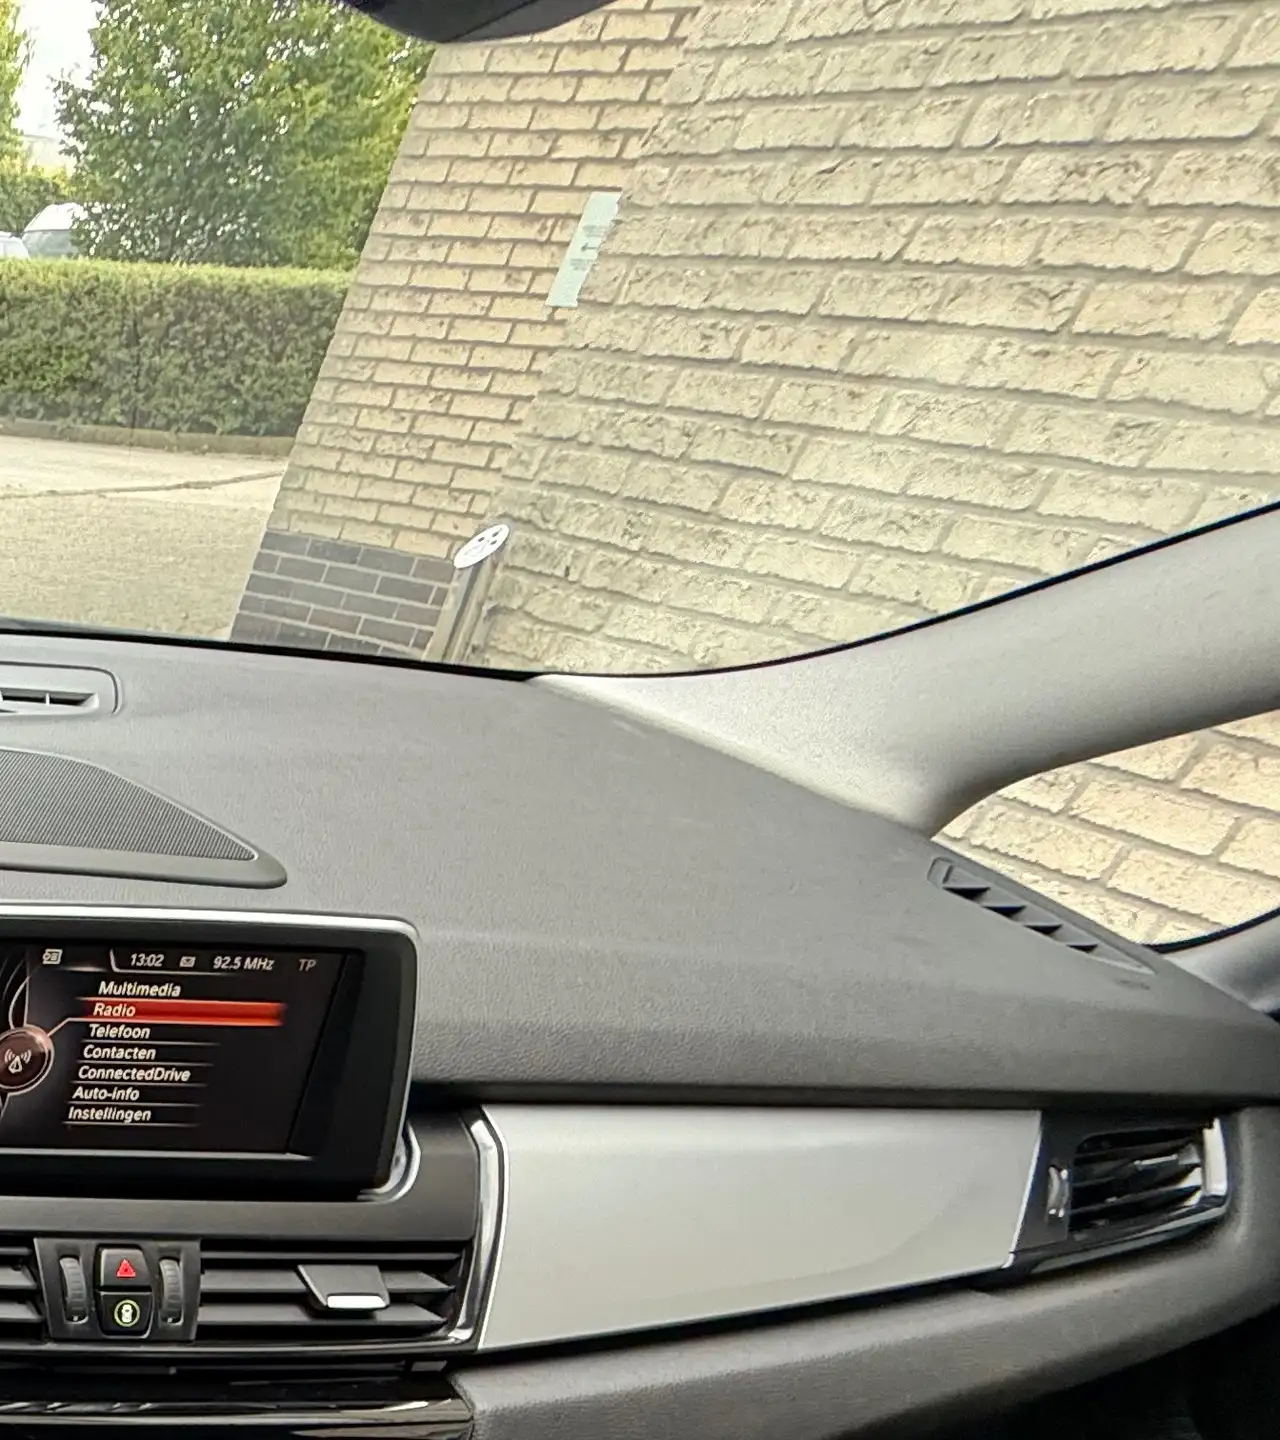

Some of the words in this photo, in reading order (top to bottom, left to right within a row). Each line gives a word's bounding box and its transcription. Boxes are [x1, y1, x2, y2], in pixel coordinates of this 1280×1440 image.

[129, 953, 165, 967] 13:02
[213, 956, 241, 970] 92.5
[244, 957, 275, 971] MHz
[299, 958, 317, 971] TP
[98, 980, 181, 998] Multimedia
[93, 1002, 136, 1017] Radio
[89, 1023, 151, 1039] Telefoon
[83, 1044, 156, 1060] Contacten
[78, 1065, 191, 1082] ConnectedDrive
[72, 1086, 140, 1101] Auto-info
[68, 1106, 152, 1123] Instellingen
